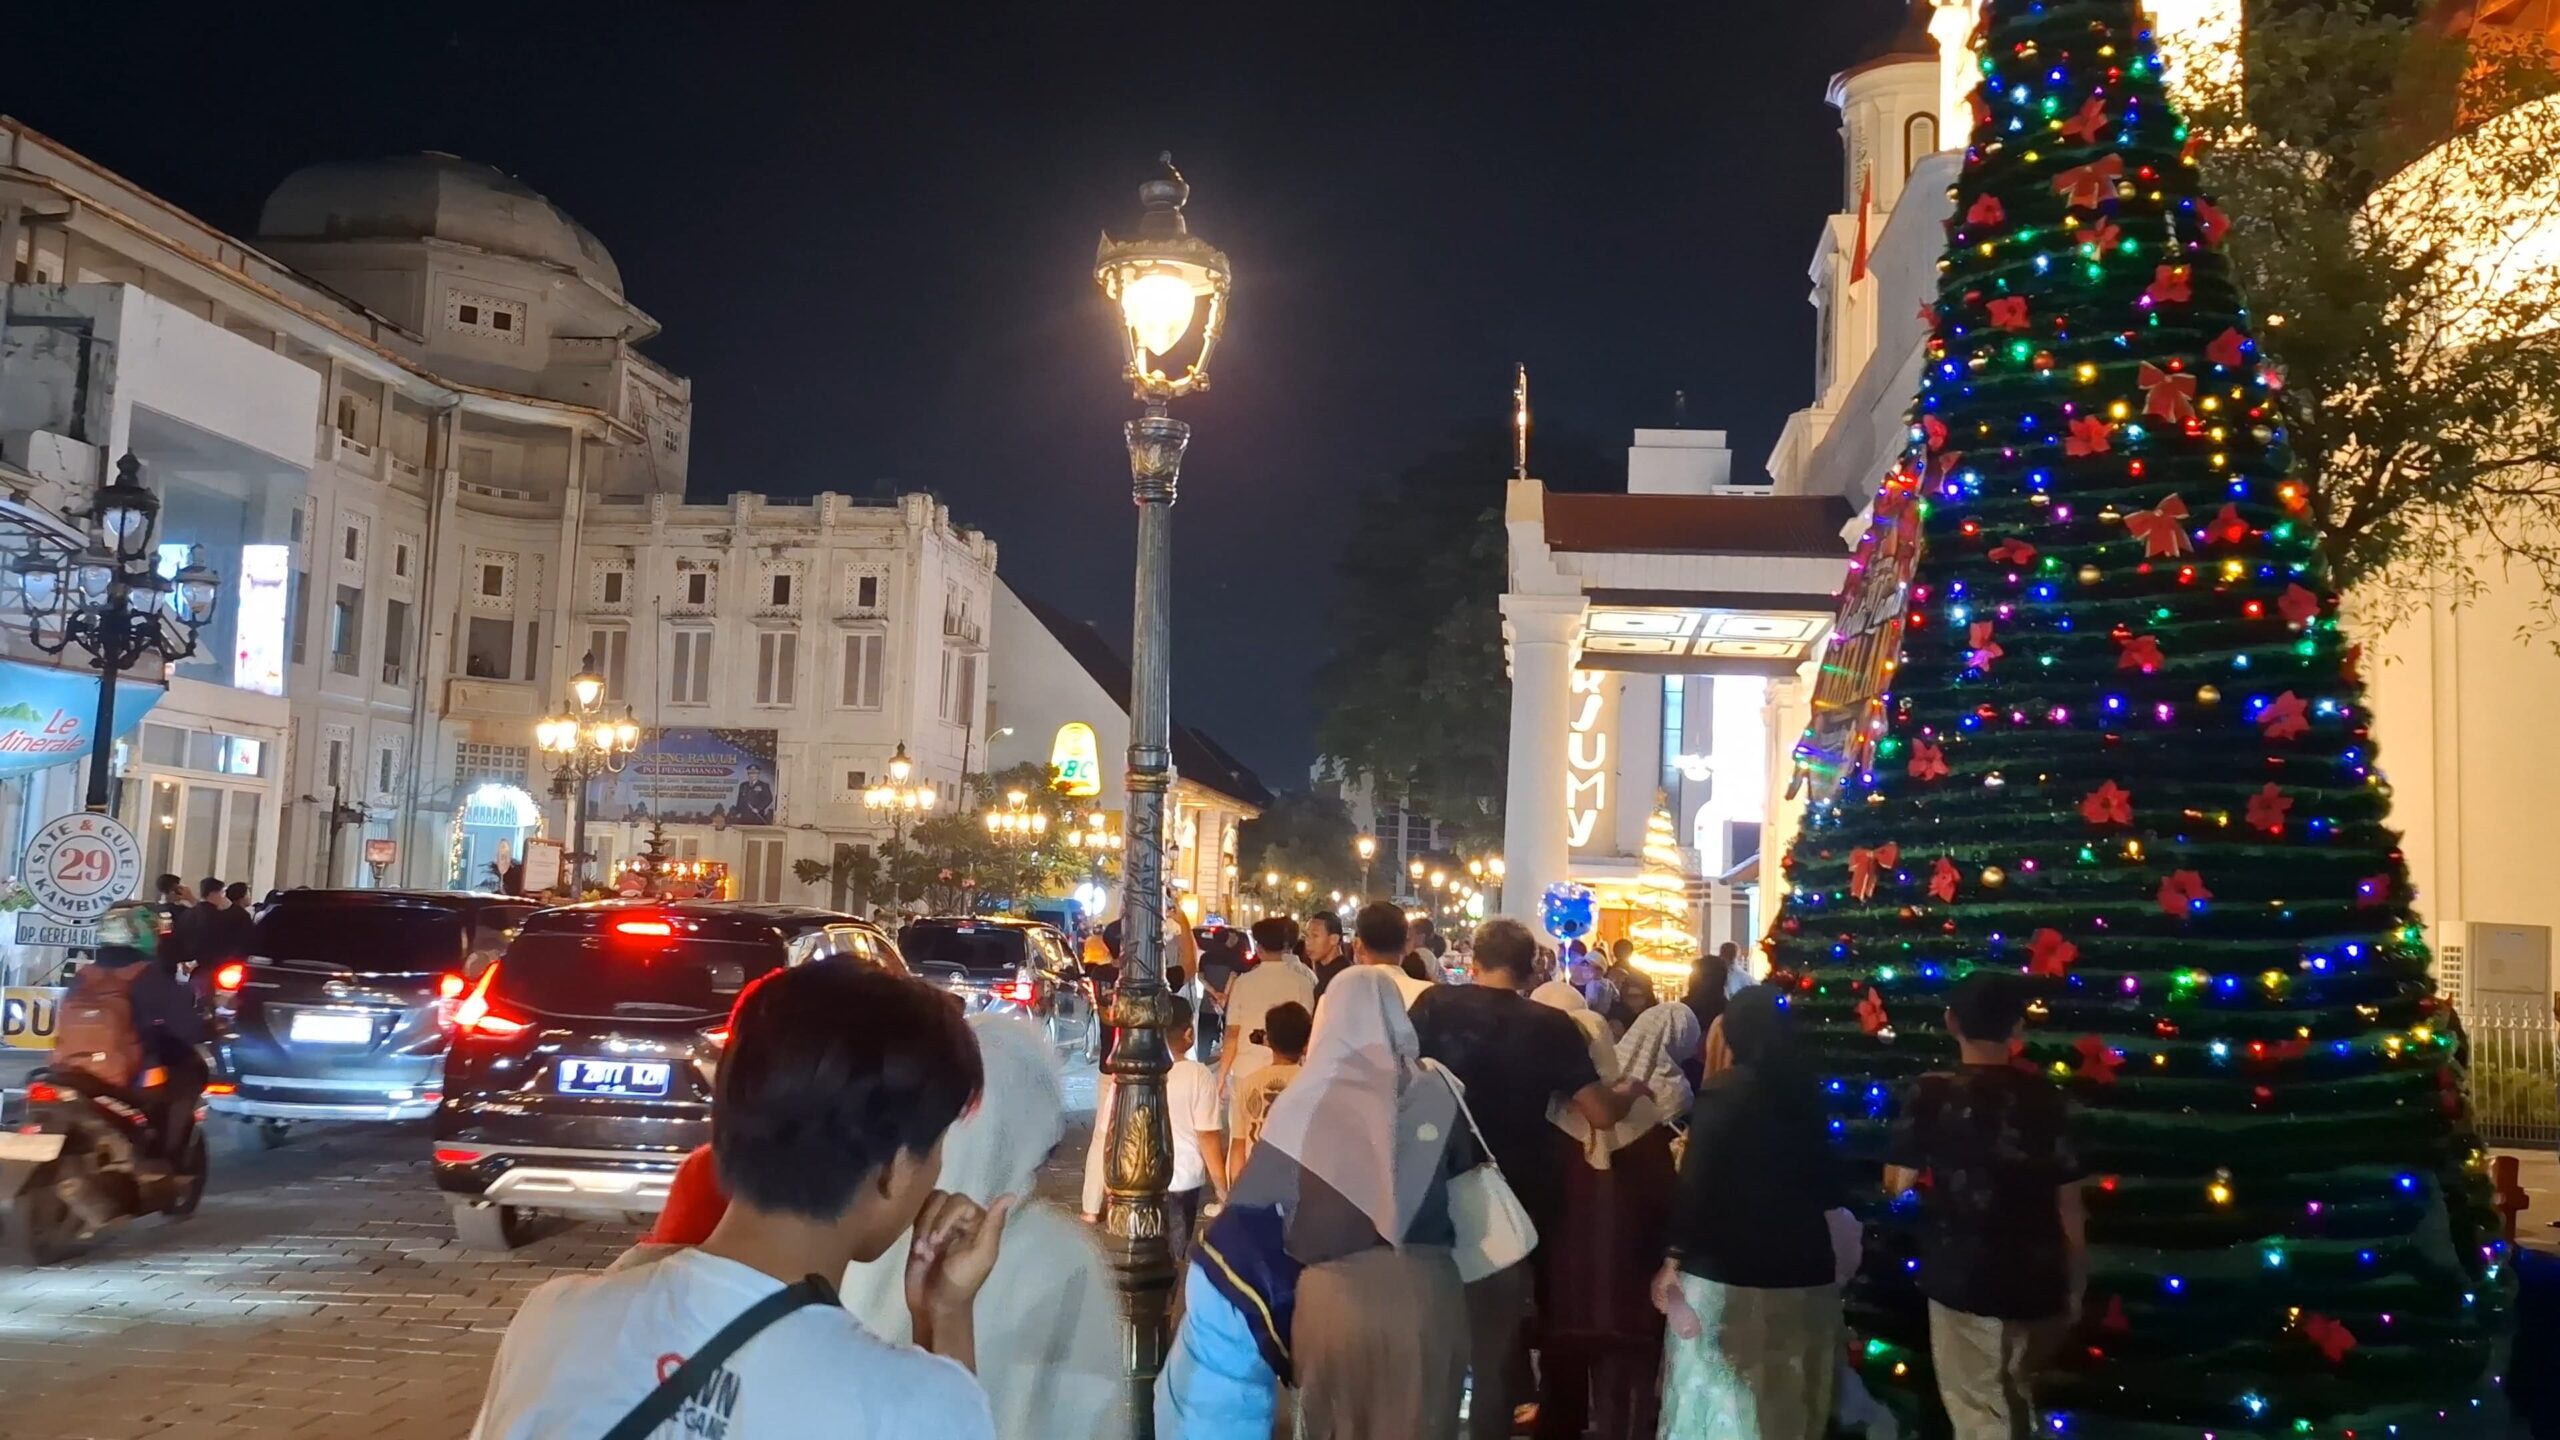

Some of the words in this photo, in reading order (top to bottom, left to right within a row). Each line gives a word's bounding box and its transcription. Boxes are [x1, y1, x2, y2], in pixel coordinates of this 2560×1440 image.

[44, 708, 79, 734] Le
[632, 752, 684, 764] SUGENG
[688, 753, 737, 765] RAWUH
[662, 767, 724, 775] PENGAMANAN
[32, 823, 73, 864] SATE
[79, 819, 94, 831] &
[101, 825, 134, 869] GULE
[57, 848, 111, 882] 29
[35, 877, 126, 912] KAMBING
[20, 925, 37, 942] DP.
[40, 927, 78, 945] GEREJA
